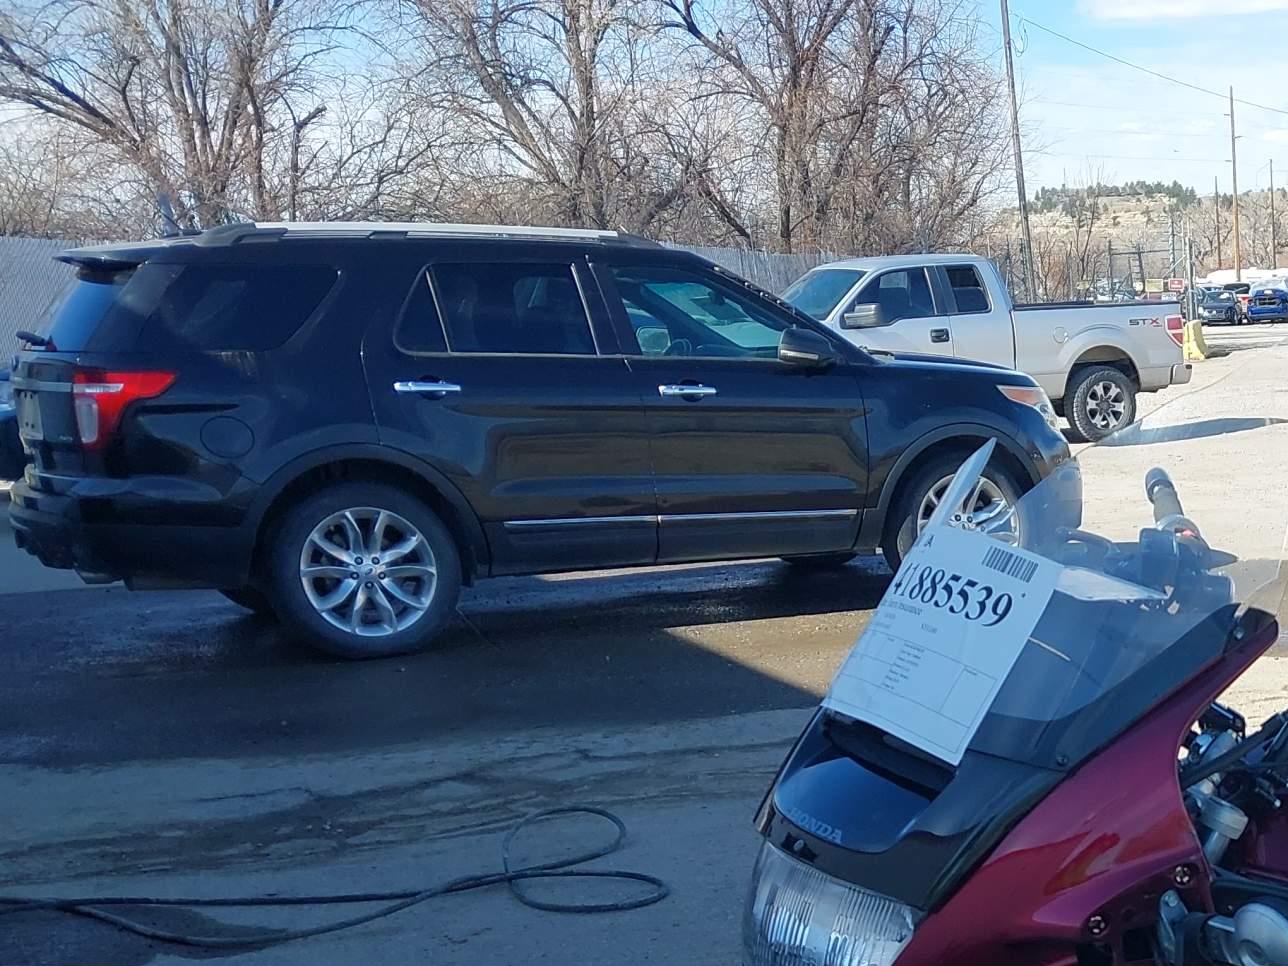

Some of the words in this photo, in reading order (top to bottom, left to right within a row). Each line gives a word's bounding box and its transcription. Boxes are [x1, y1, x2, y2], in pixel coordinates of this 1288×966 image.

[1129, 318, 1160, 327] STX
[893, 562, 1013, 628] 41885539
[787, 807, 843, 845] HONDA
